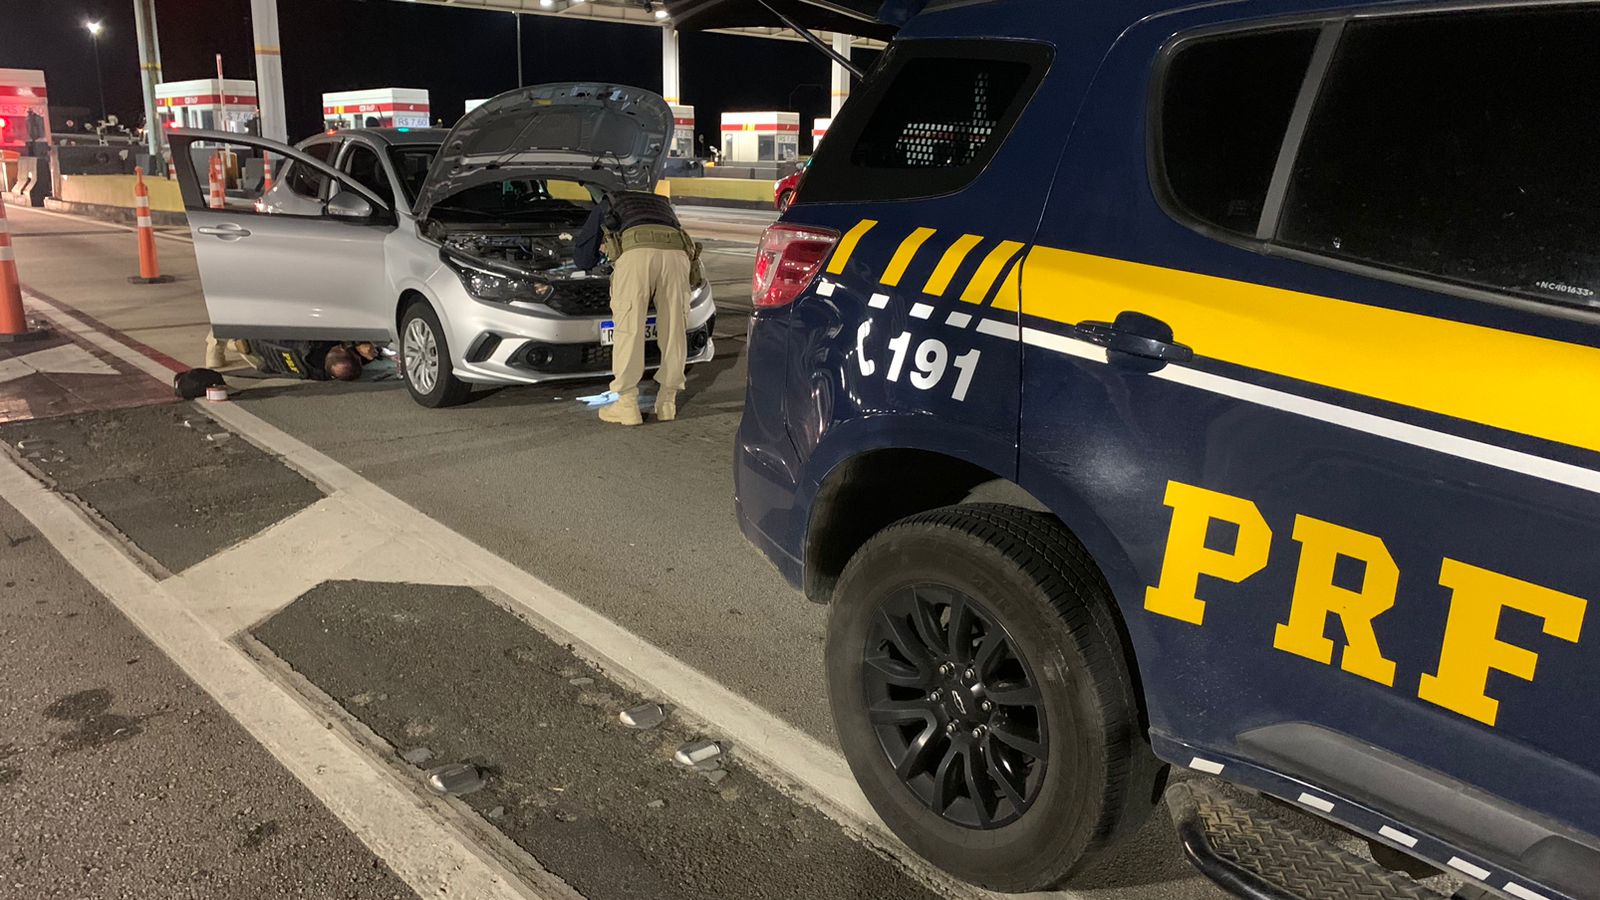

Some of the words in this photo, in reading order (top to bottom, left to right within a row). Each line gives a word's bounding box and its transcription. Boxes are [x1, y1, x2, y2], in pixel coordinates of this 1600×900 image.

[282, 352, 300, 374] PRF
[886, 331, 981, 402] 191
[1144, 480, 1587, 726] PRF
